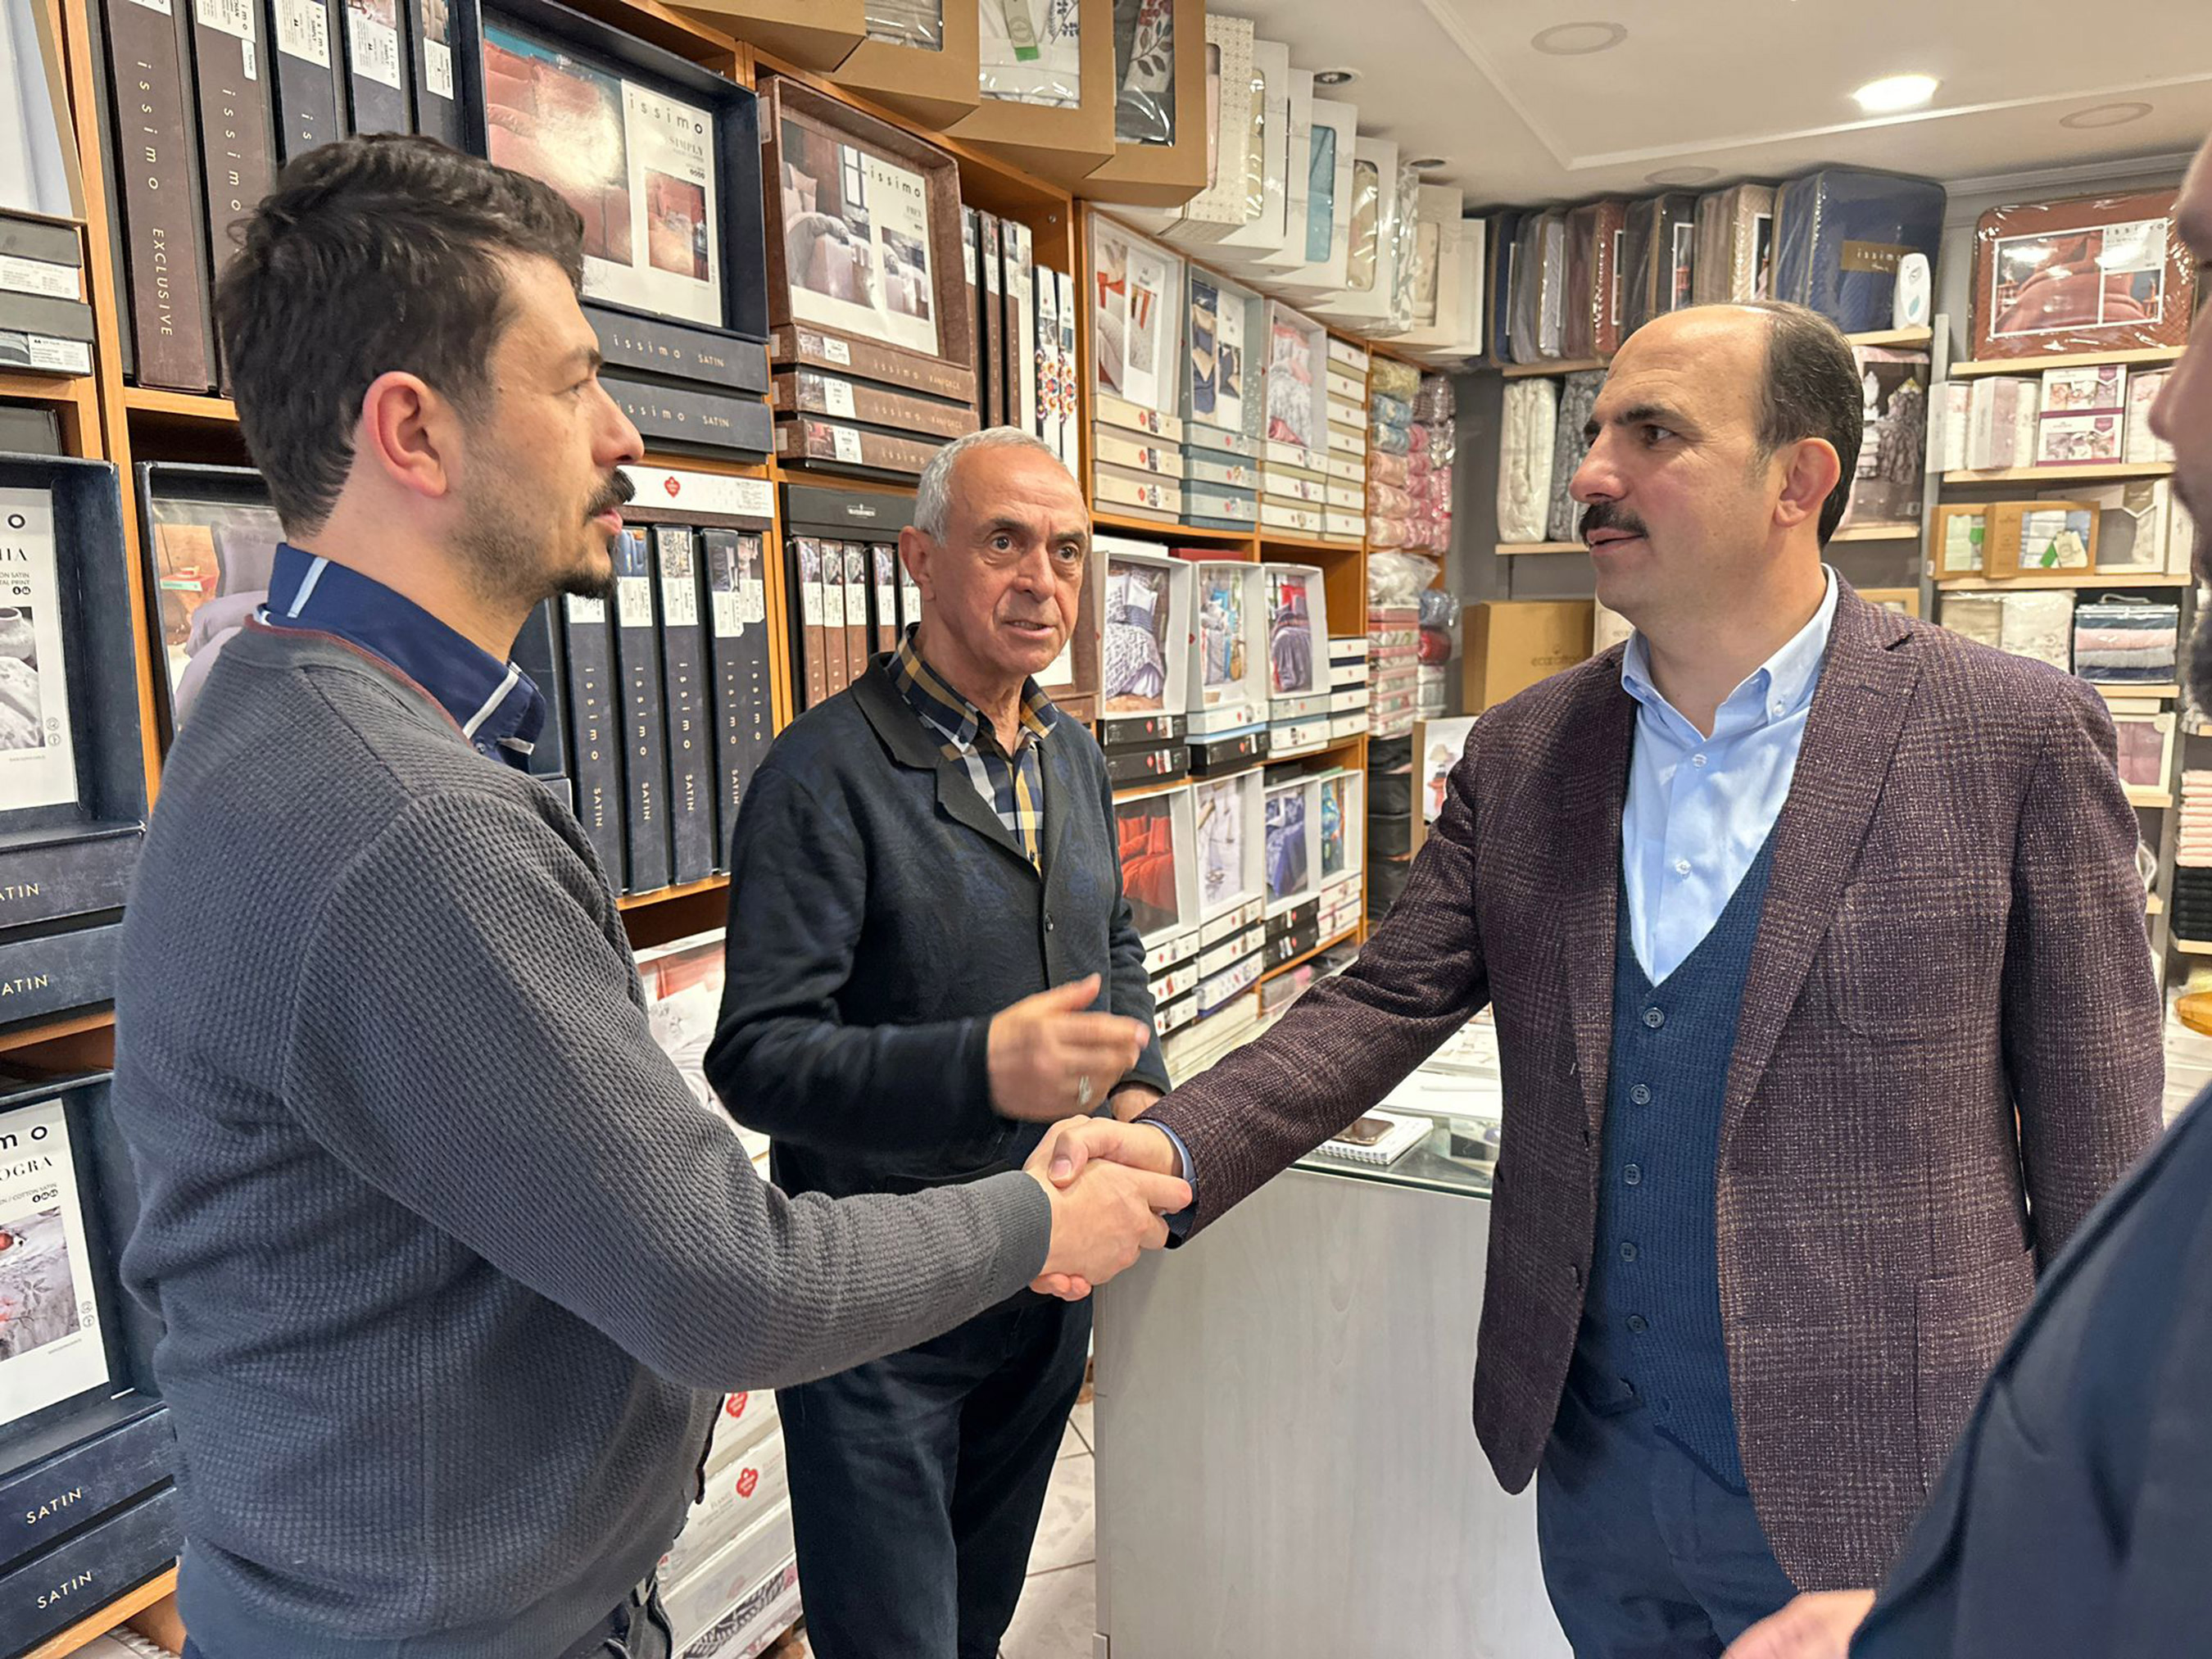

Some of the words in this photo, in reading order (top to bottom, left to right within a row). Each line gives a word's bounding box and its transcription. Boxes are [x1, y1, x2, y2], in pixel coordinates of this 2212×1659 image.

[629, 93, 704, 135] issimo
[222, 88, 243, 212] issimo
[137, 61, 159, 190] issimo
[152, 228, 173, 337] EXCLUSIVE
[870, 164, 921, 198] issimo
[613, 333, 682, 359] issimo
[698, 353, 725, 368] SATIN
[702, 415, 730, 428] SATIN
[0, 547, 27, 562] IA
[726, 661, 737, 746] issimo
[751, 660, 762, 741] issimo
[585, 668, 600, 761] issimo
[593, 786, 604, 828] SATIN
[635, 666, 647, 756] issimo
[641, 782, 651, 821] SATIN
[678, 662, 691, 750] issimo
[685, 773, 695, 812] SATIN
[731, 768, 741, 805] SATIN
[2, 974, 48, 996] ATIN
[26, 1487, 82, 1525] SATIN
[37, 1571, 93, 1610] SATIN
